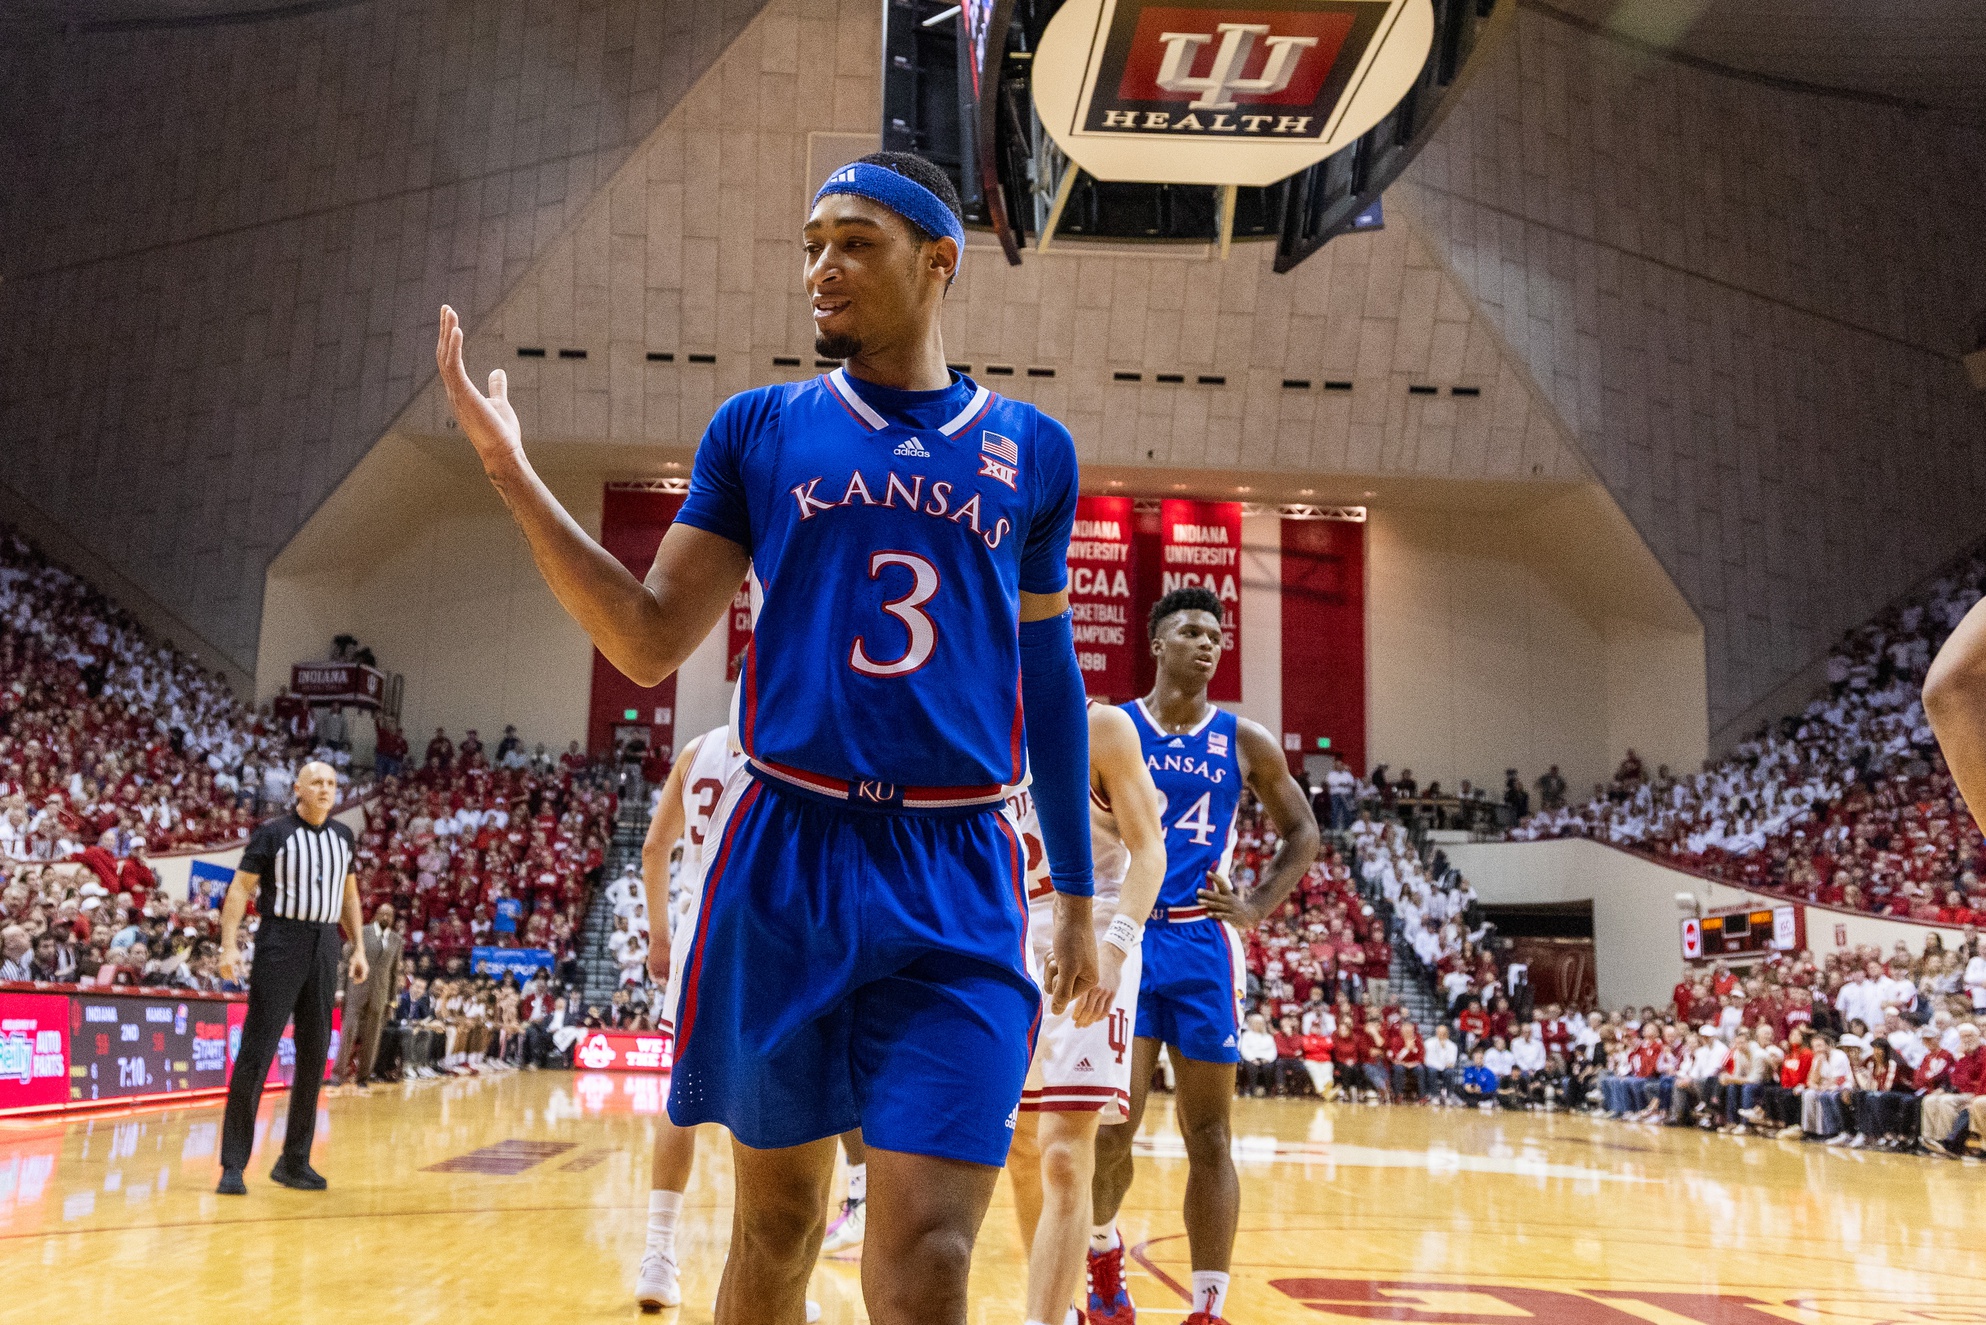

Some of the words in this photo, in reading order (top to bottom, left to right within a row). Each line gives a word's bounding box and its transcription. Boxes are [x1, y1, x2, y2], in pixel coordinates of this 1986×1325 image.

[1102, 109, 1314, 133] HEALTH
[893, 447, 930, 458] adidas
[977, 453, 1018, 492] XII
[791, 469, 1010, 549] KANSAS
[1070, 520, 1121, 540] NDIANA
[1173, 524, 1229, 544] INDIANA
[1067, 541, 1129, 562] NIVERSITY
[1164, 544, 1237, 566] UNIVERSITY
[848, 549, 941, 679] 3
[1073, 603, 1127, 624] SKETBALL
[1074, 624, 1125, 645] AMPIONS
[1079, 652, 1107, 672] 1981
[298, 670, 348, 683] INDIANA
[1147, 754, 1227, 784] ANSAS
[858, 780, 895, 803] KU
[85, 1006, 118, 1023] INDIANA
[145, 1006, 173, 1023] KANSAS
[36, 1030, 62, 1054] AUTO
[121, 1024, 140, 1042] 2ND
[33, 1053, 65, 1078] PARTS
[117, 1056, 146, 1088] 7:10
